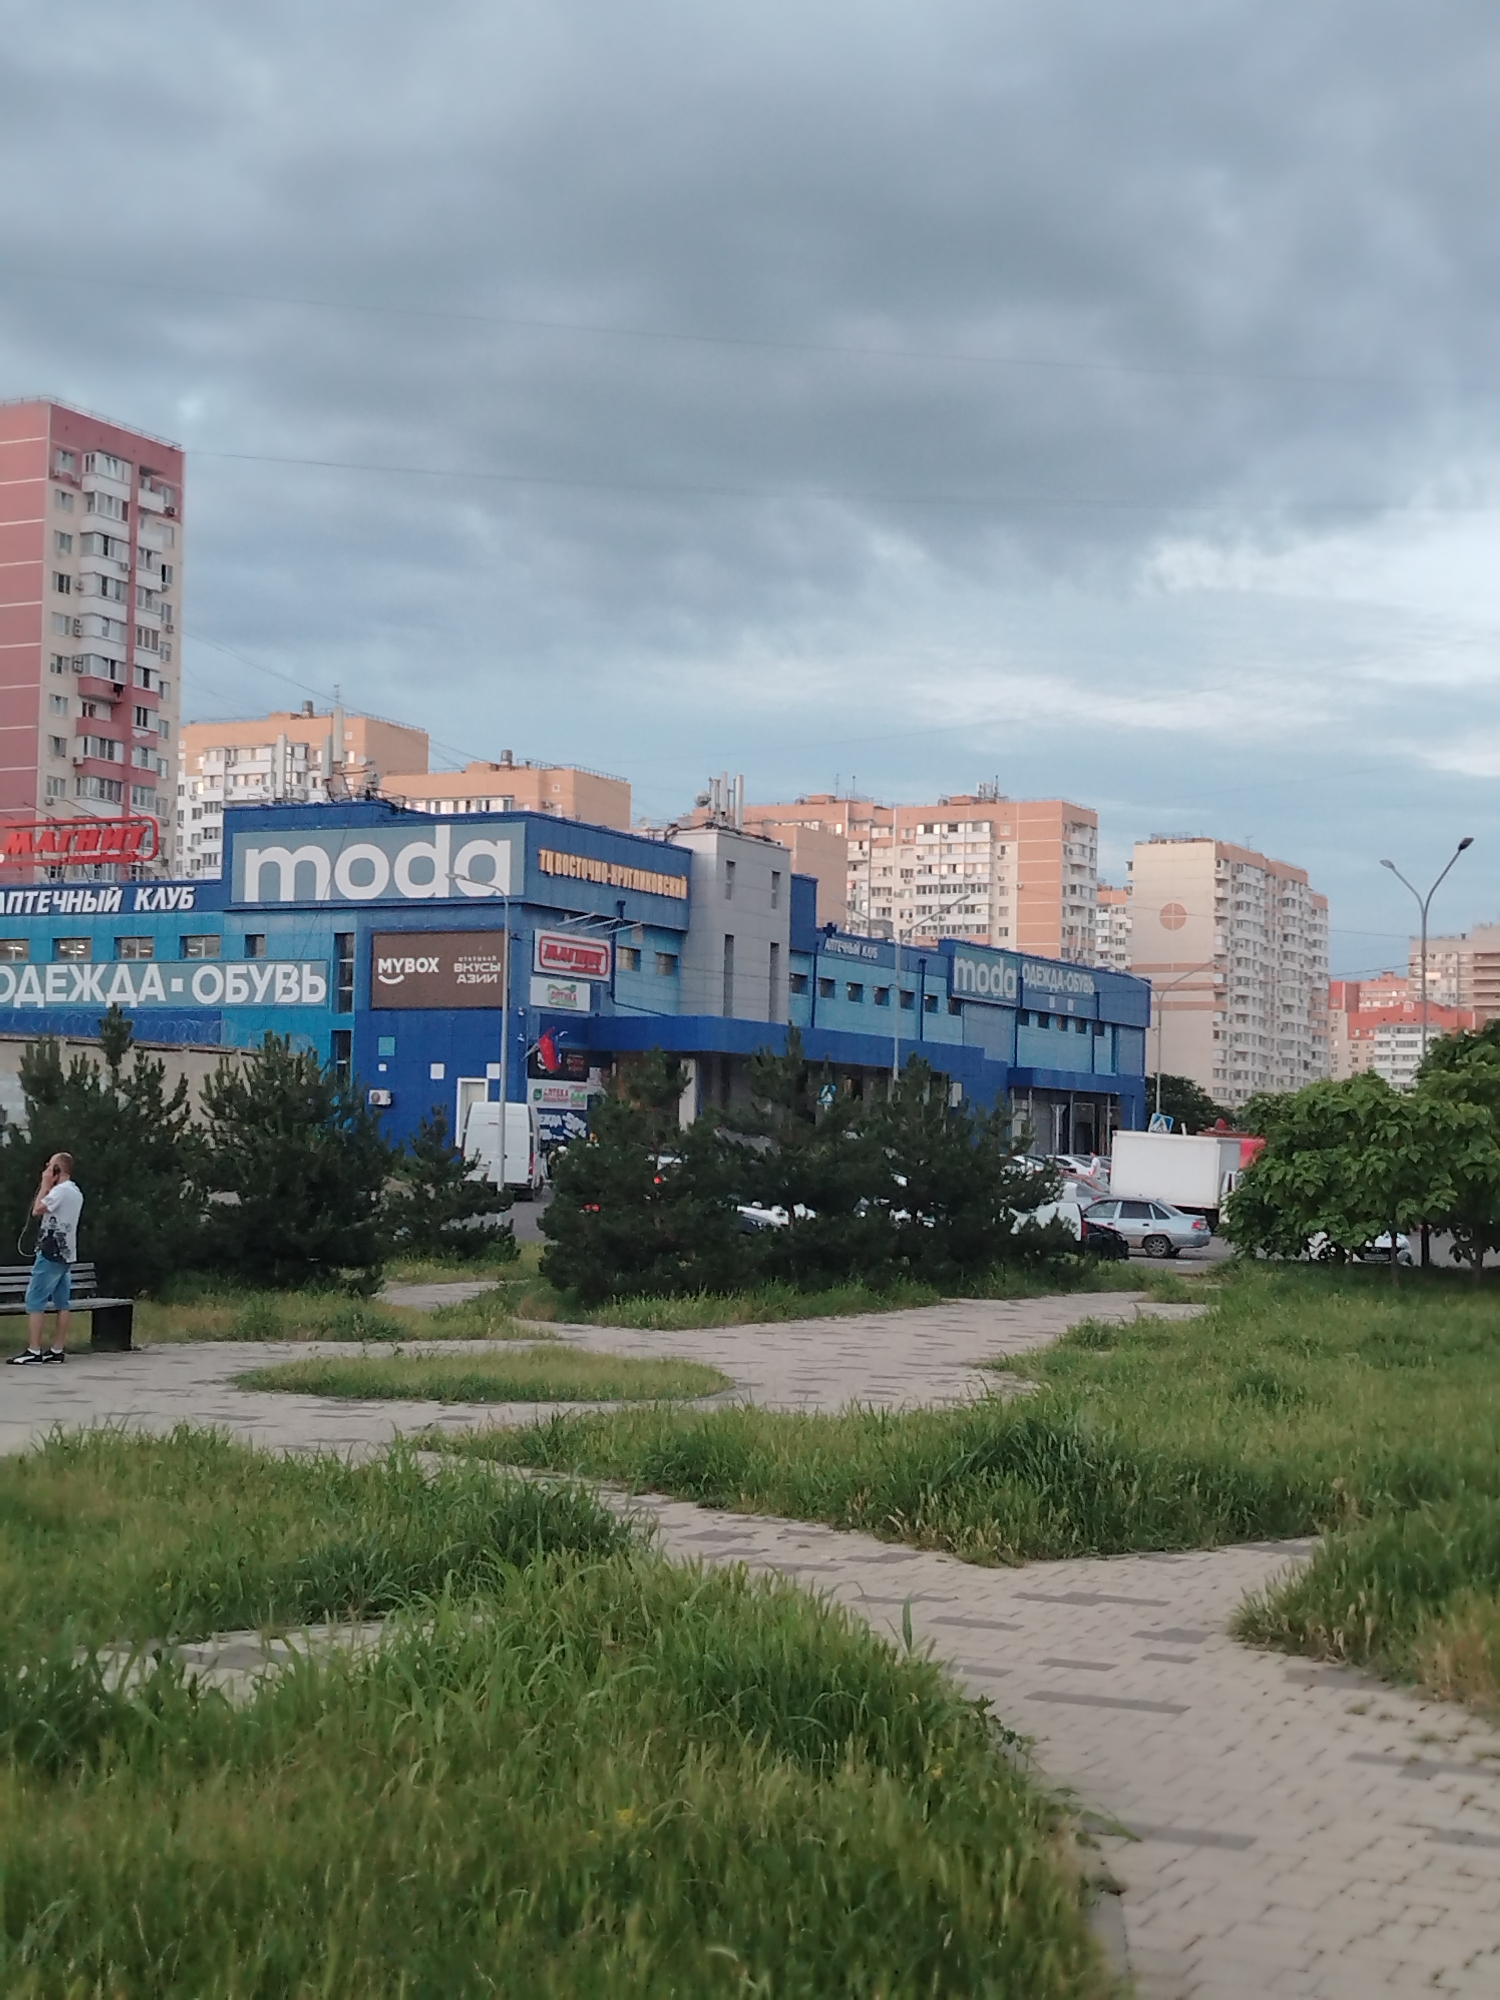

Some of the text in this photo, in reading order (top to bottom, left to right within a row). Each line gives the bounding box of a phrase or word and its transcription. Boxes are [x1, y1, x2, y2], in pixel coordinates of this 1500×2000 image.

[4, 827, 148, 854] МАГНИТ
[243, 824, 511, 903] moda
[538, 849, 554, 876] ТЦ
[134, 886, 196, 911] КЛУБ
[378, 957, 440, 974] MYBOX
[453, 962, 502, 973] ВКУСЫ
[456, 973, 499, 984] АЗИИ
[953, 956, 1018, 999] moda
[192, 963, 327, 1005] ОБУВЬ
